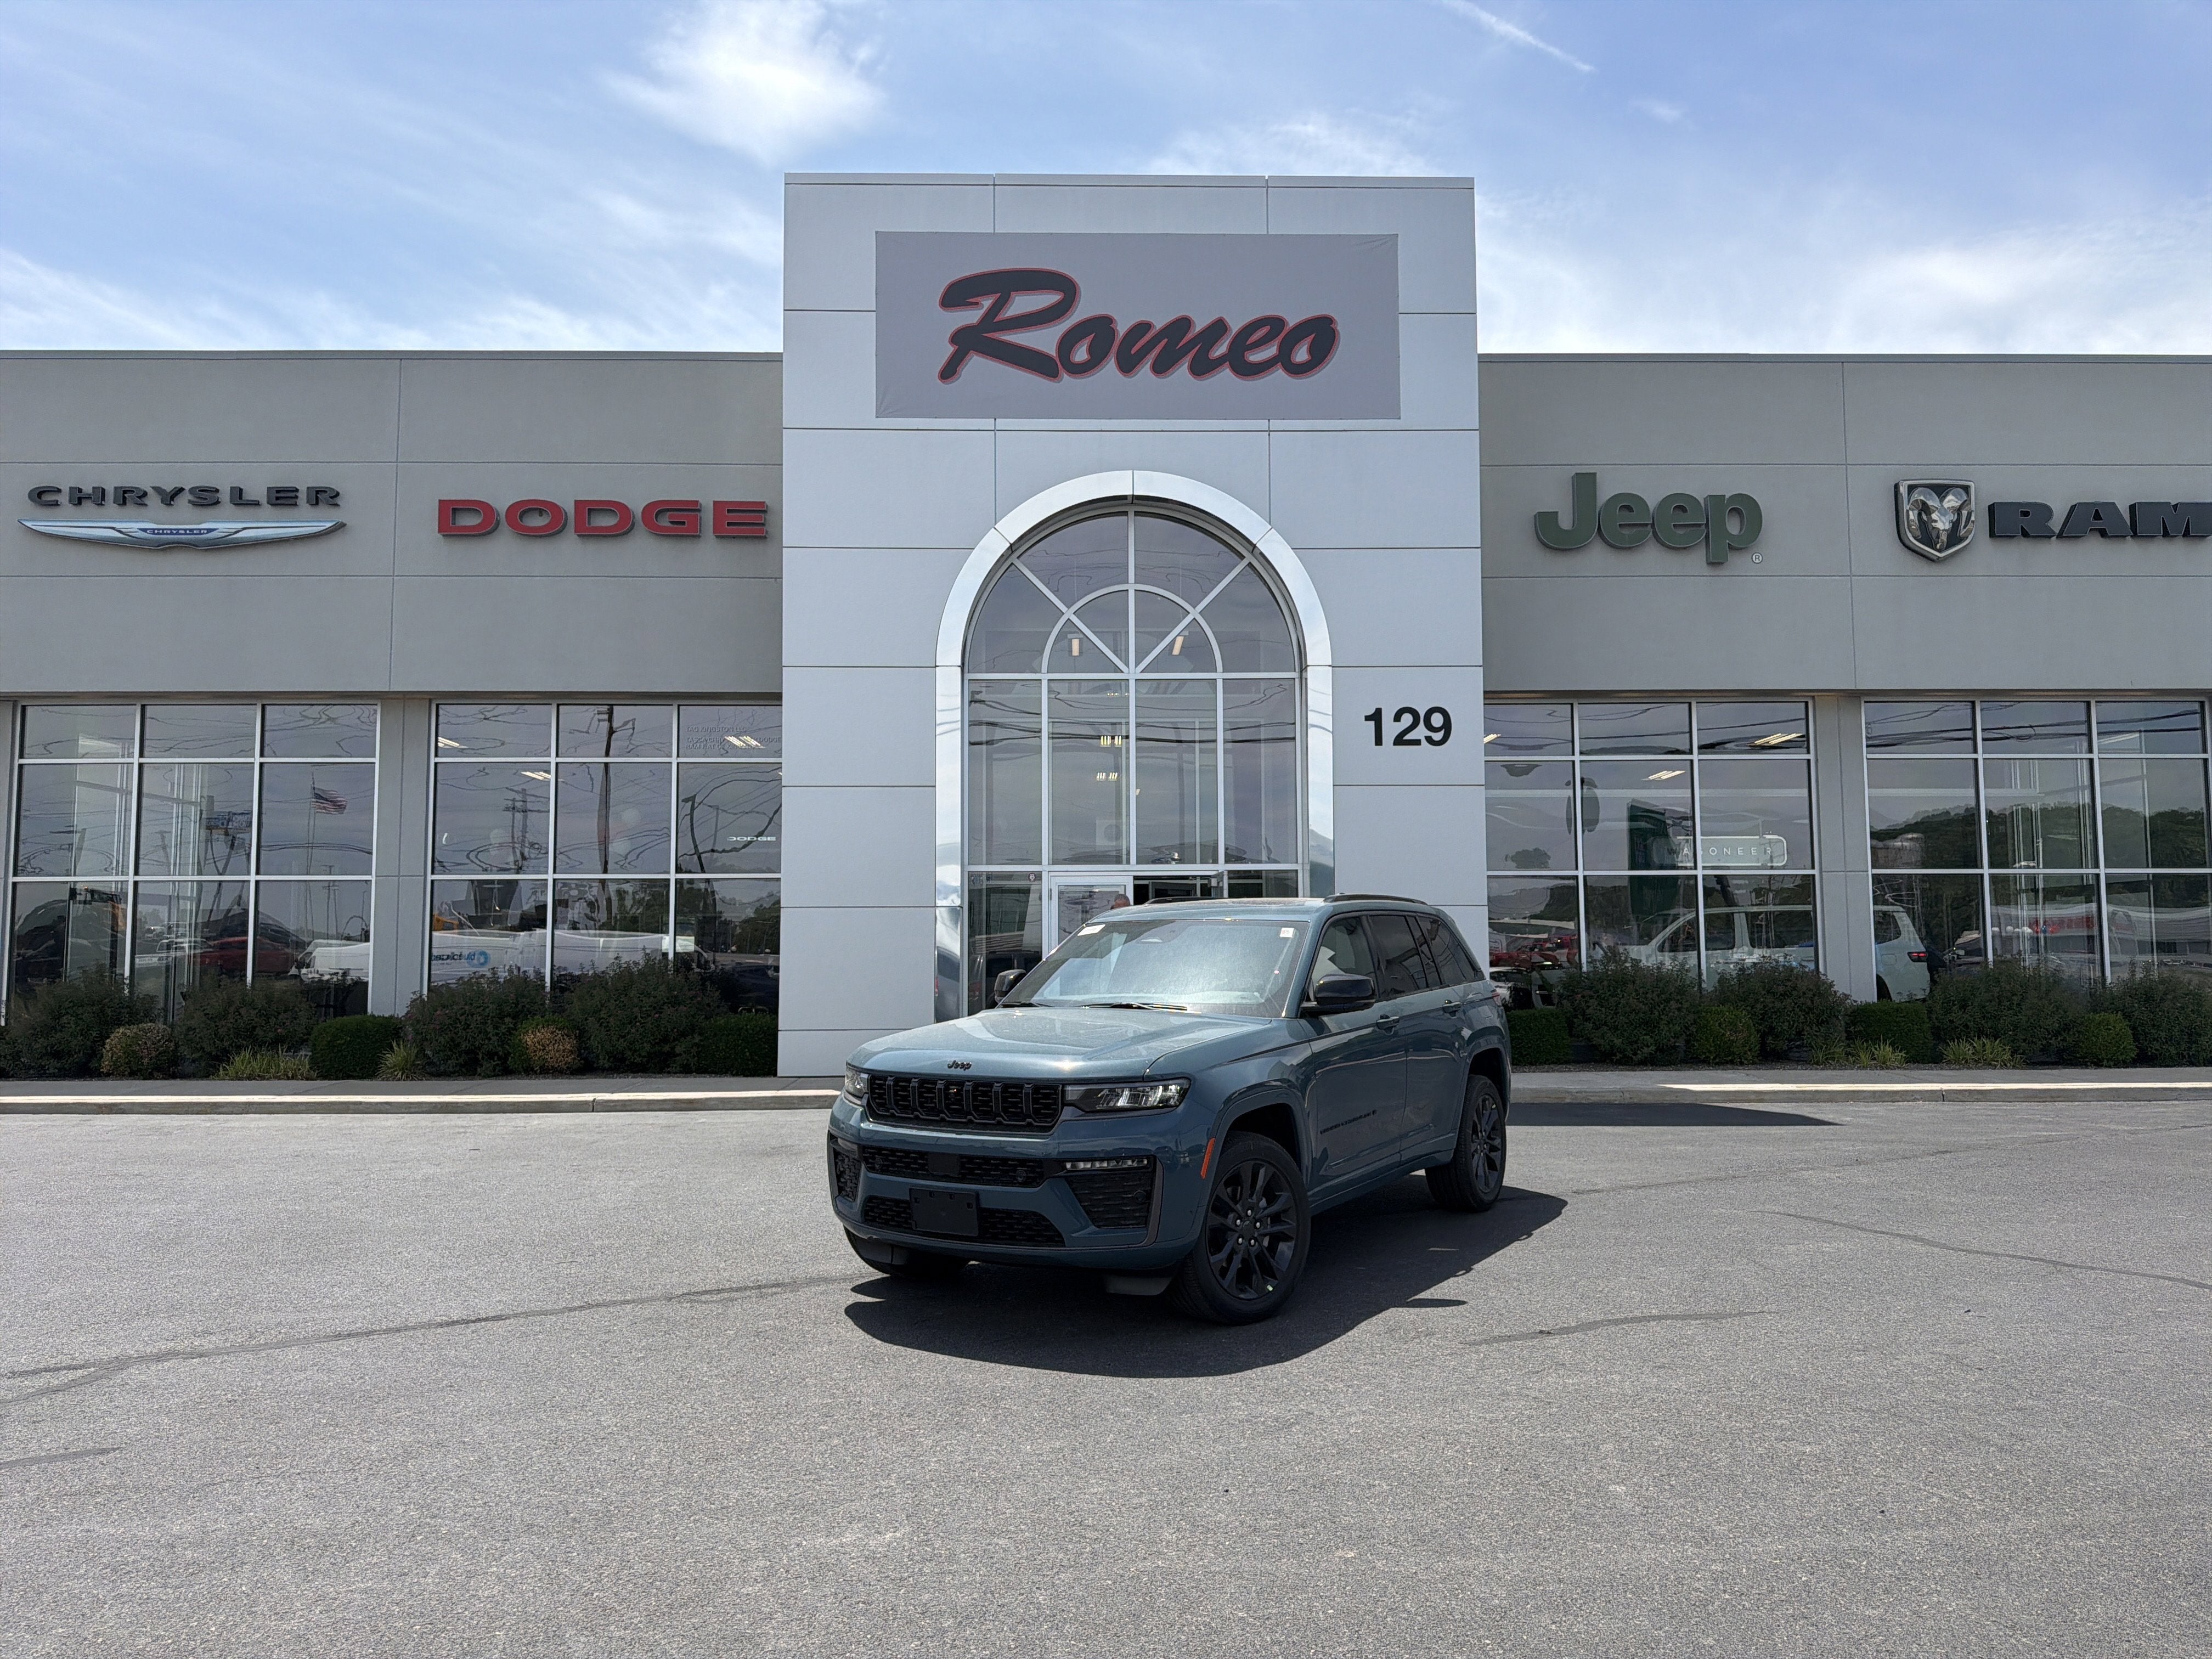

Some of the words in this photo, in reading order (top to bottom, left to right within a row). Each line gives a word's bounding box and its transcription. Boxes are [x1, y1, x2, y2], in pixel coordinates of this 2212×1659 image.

[938, 267, 1341, 383] Romeo
[27, 486, 341, 506] CHRYSLER
[438, 499, 768, 538] DODGE
[1534, 472, 1763, 564] Jeep
[1988, 501, 2212, 538] RAM
[1364, 706, 1452, 747] 129
[947, 1059, 972, 1071] Jeep
